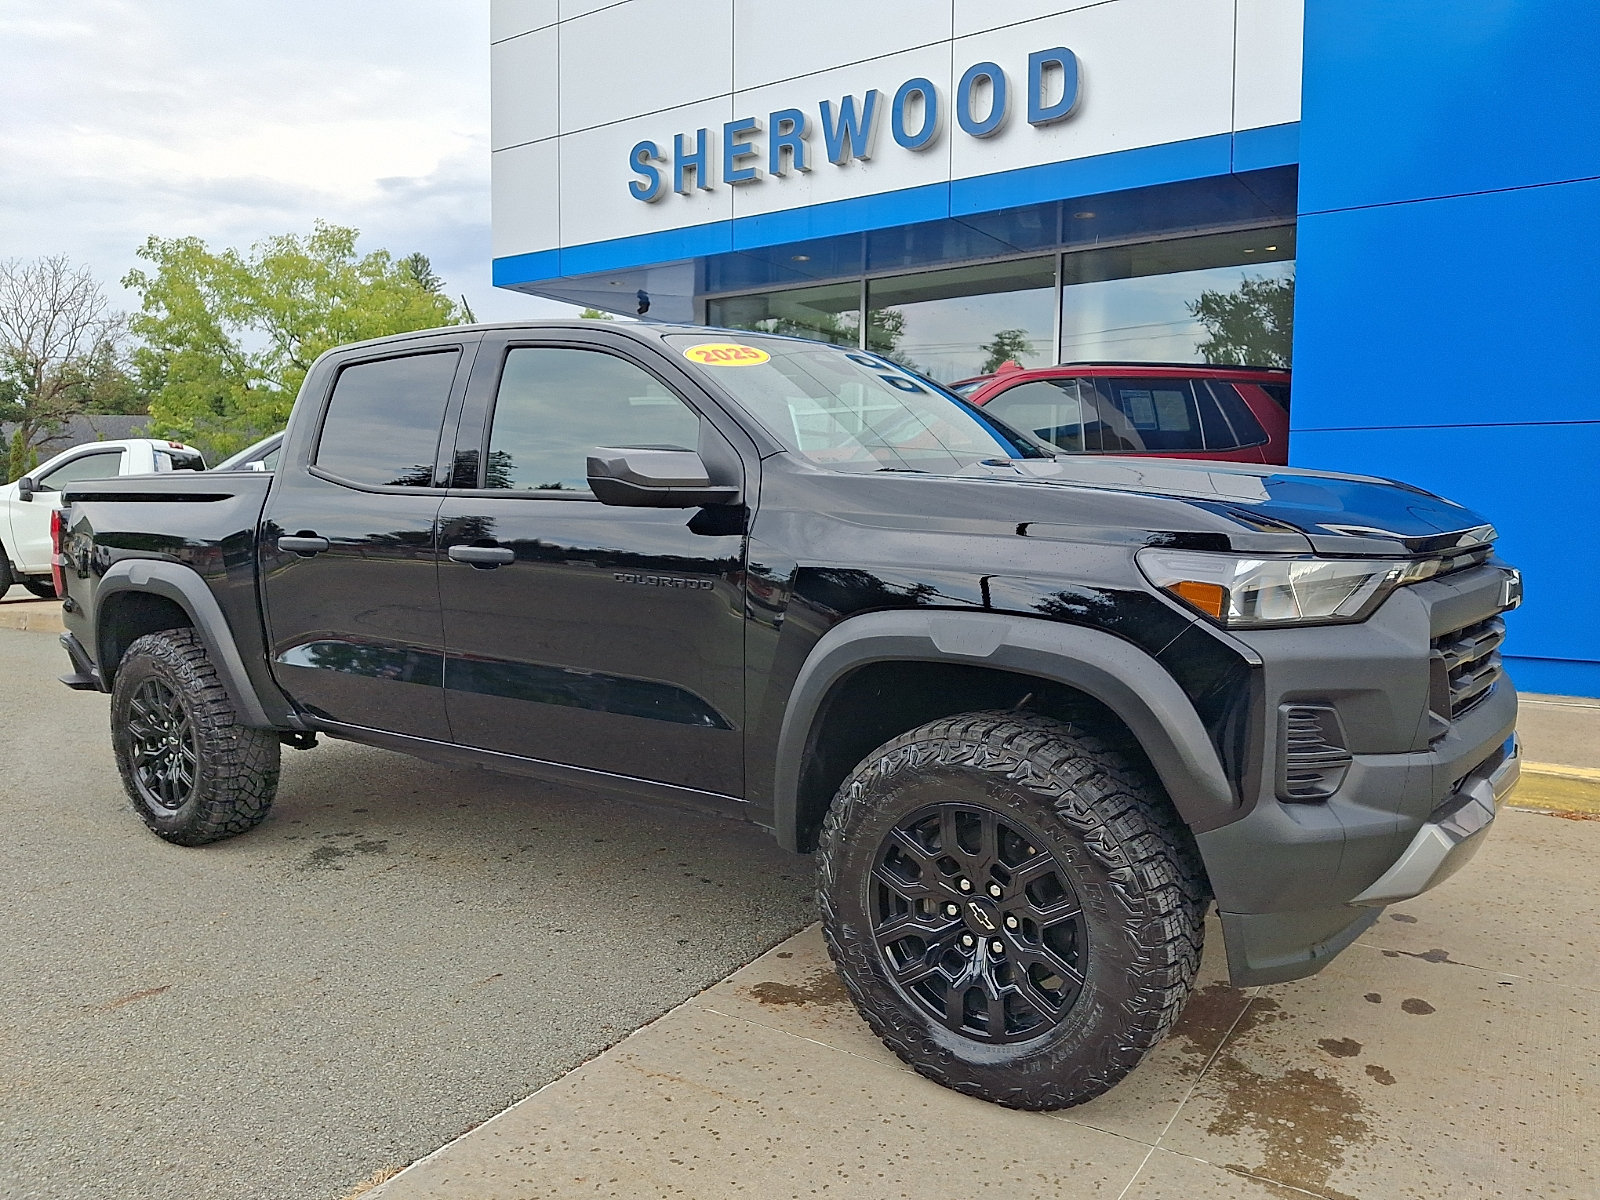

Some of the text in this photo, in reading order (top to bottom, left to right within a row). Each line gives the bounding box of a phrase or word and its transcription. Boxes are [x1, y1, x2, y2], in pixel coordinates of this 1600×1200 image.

[628, 46, 1083, 203] SHERWOOD
[696, 347, 760, 362] 2025
[613, 572, 714, 590] COLORADO
